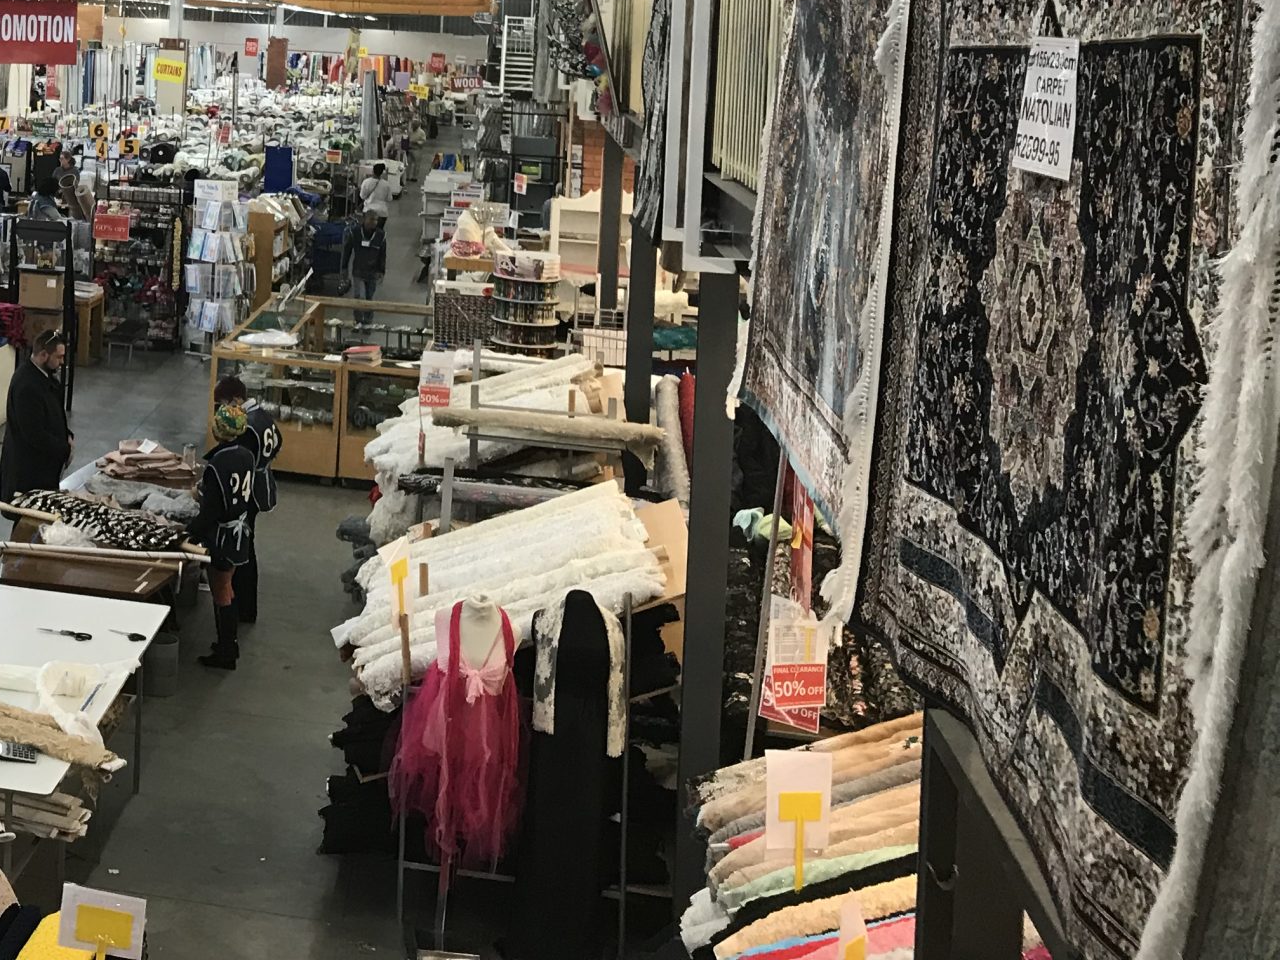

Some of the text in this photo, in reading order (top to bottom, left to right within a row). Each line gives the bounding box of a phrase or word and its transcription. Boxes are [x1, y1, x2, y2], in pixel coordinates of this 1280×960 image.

[156, 62, 183, 79] CURTAINS
[453, 78, 480, 88] WOOL
[1036, 76, 1068, 96] CARPET
[0, 117, 6, 129] 7
[94, 124, 104, 137] 6
[98, 142, 105, 157] 4
[123, 140, 134, 153] 5
[420, 394, 439, 404] 50%
[774, 680, 806, 697] 50%
[807, 687, 824, 696] OFF
[801, 708, 818, 720] OFF
